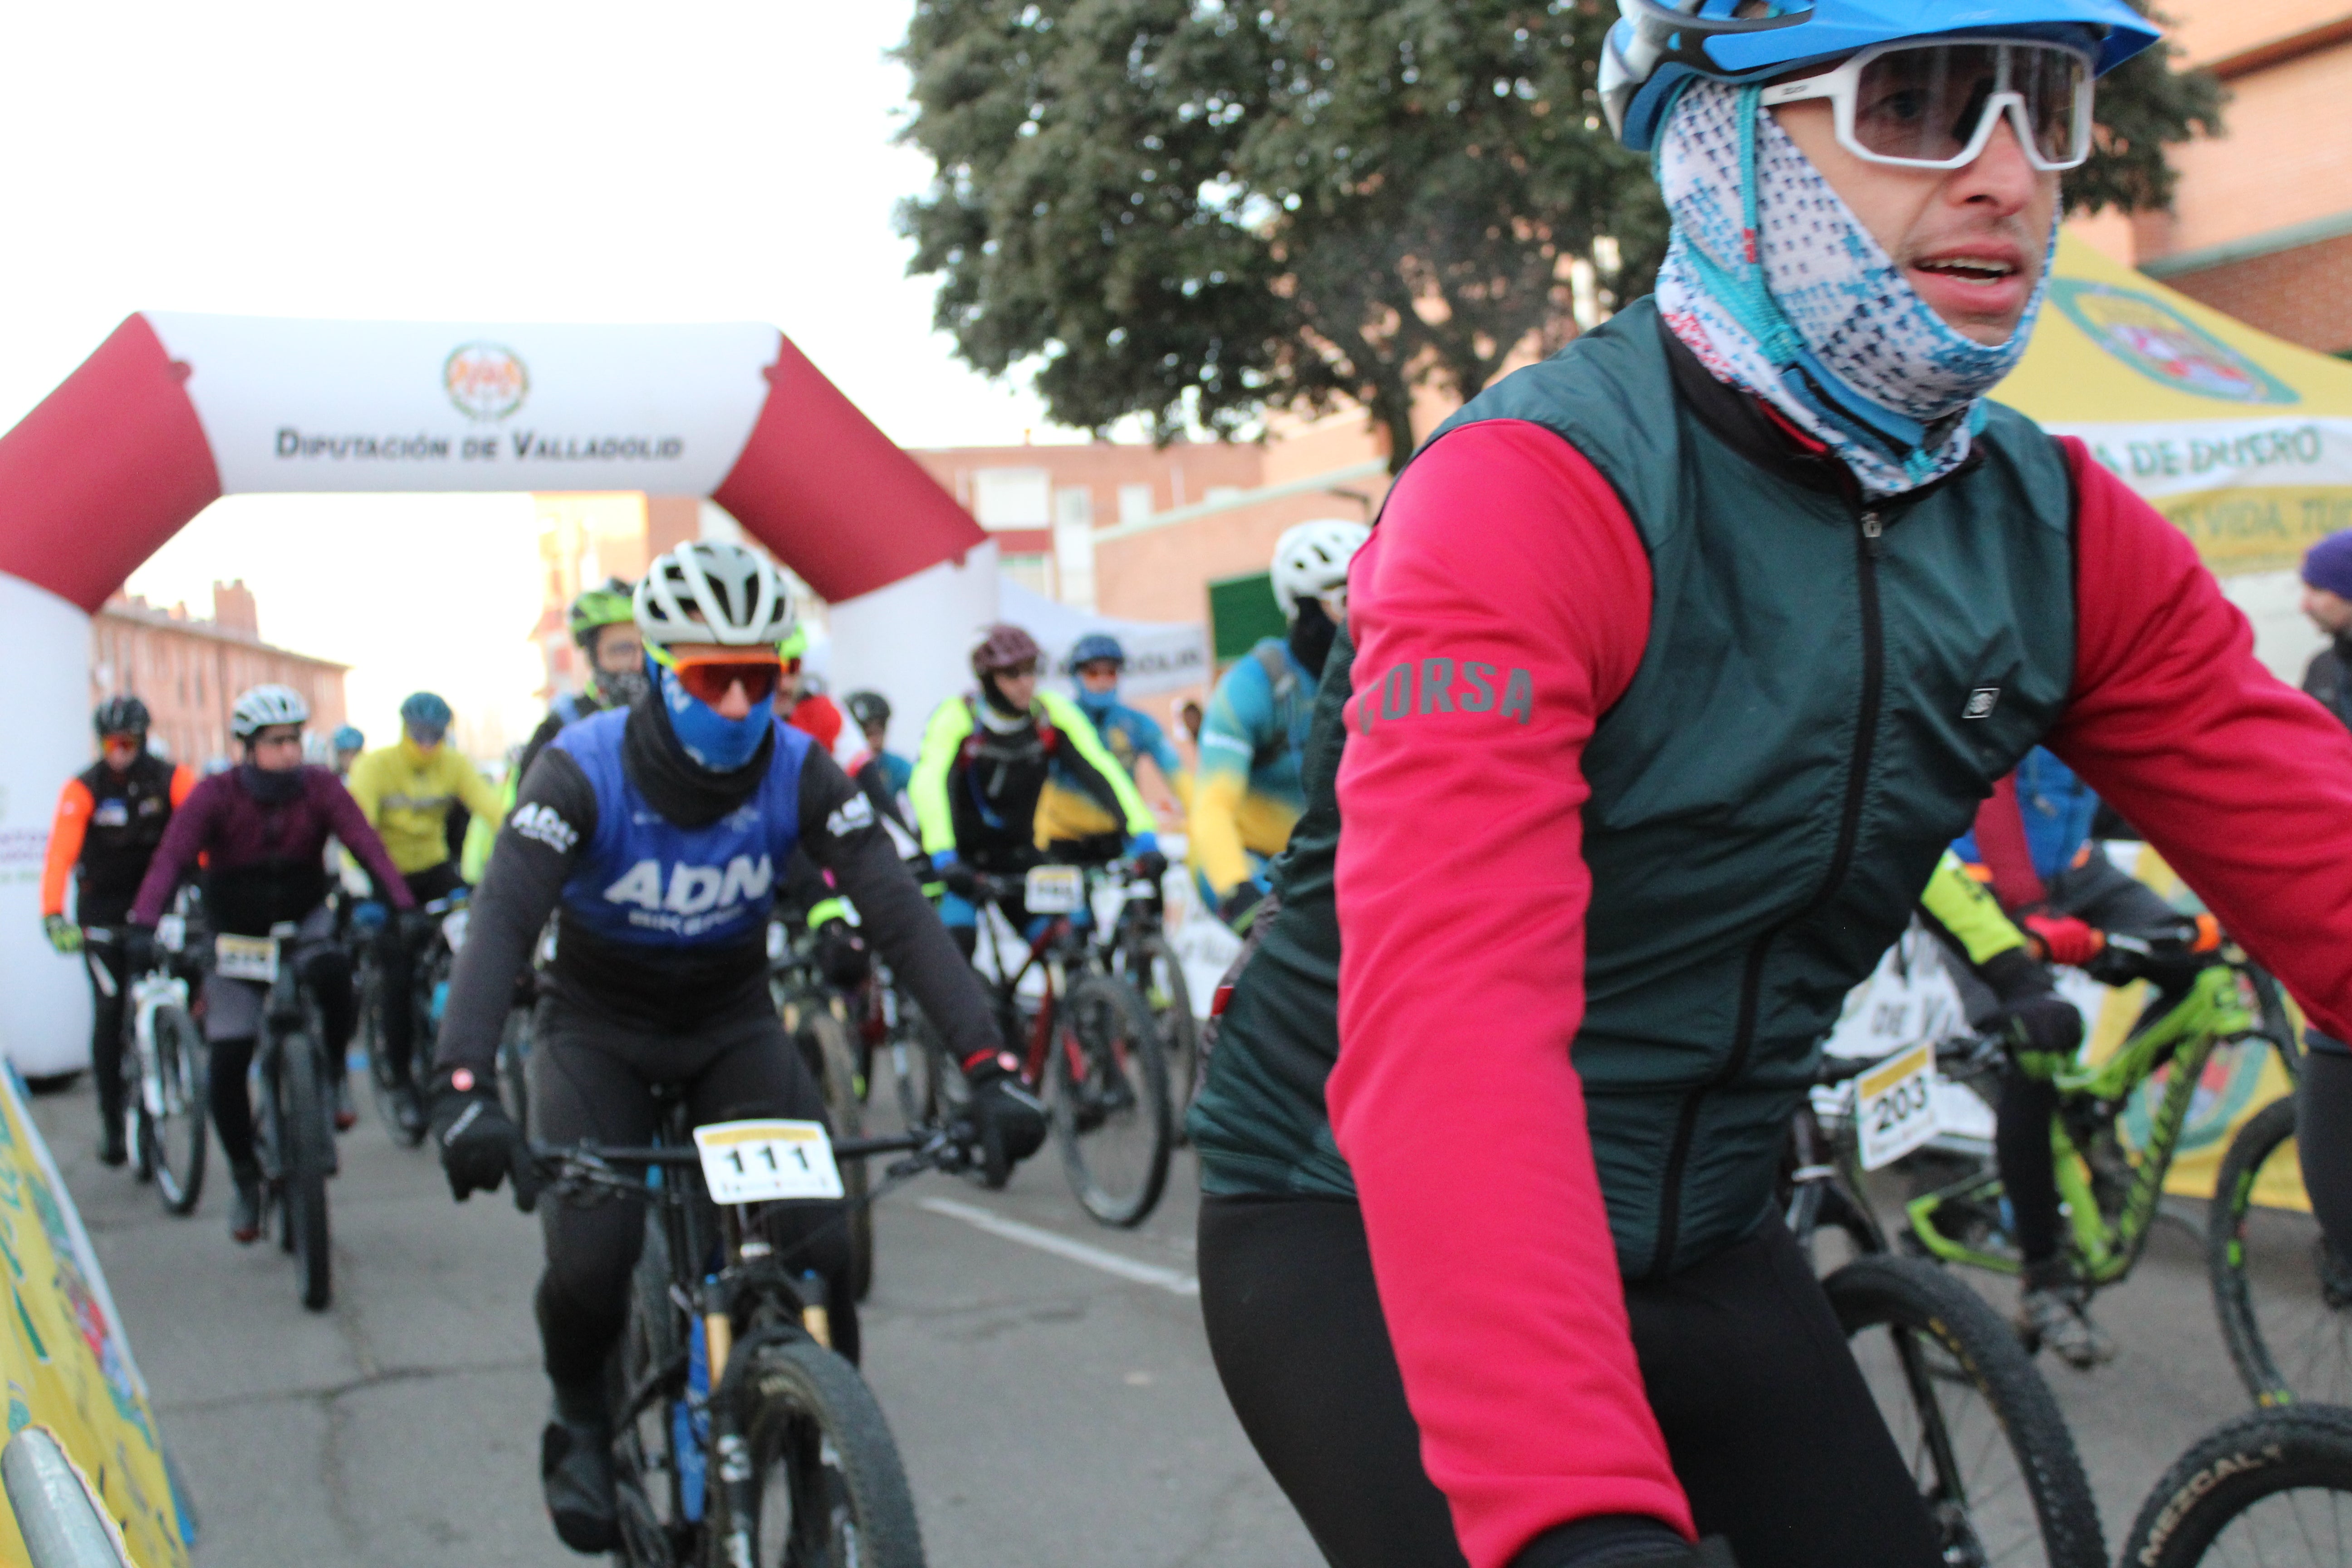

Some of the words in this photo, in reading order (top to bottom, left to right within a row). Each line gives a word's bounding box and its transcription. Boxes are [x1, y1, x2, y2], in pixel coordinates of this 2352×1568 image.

[462, 436, 498, 460] DE
[512, 427, 684, 461] VALLADOLID
[2129, 439, 2180, 476] DE
[603, 853, 772, 915] ADN
[1873, 1075, 1927, 1132] 203
[725, 1144, 809, 1173] 111
